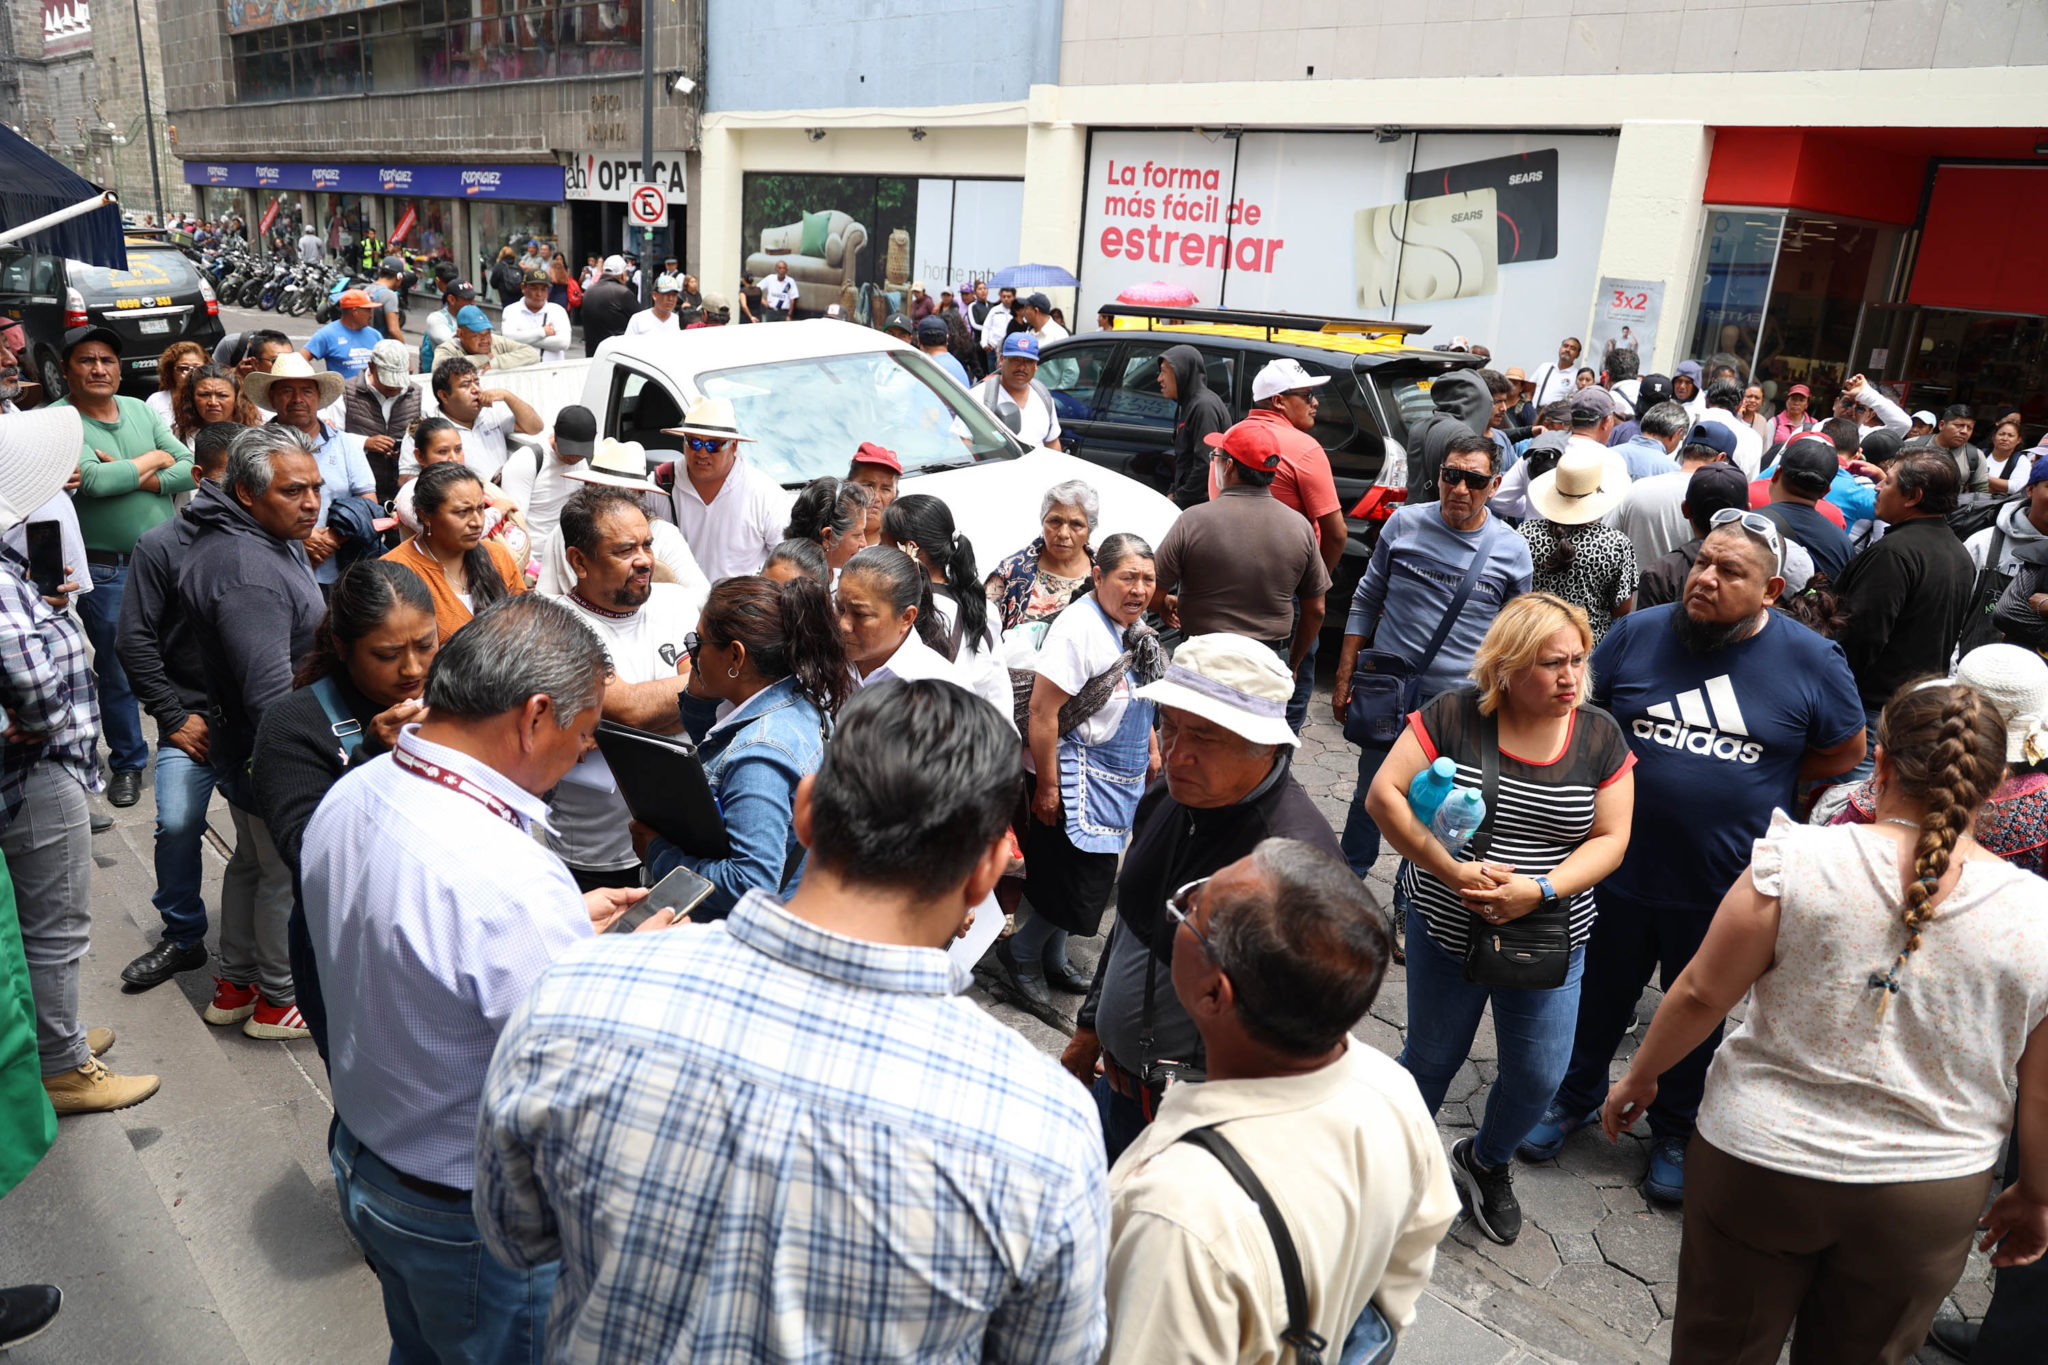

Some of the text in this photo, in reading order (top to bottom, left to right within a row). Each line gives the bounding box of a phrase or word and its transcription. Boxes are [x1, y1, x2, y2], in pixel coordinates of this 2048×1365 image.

[598, 160, 685, 193] OPTCA
[1107, 160, 1220, 191] La forma
[1508, 170, 1543, 186] SEARS
[642, 193, 655, 216] E
[1104, 190, 1262, 226] más fácil de
[1450, 209, 1484, 224] SEARS
[1100, 223, 1285, 274] estrenar
[923, 258, 965, 283] home
[1611, 289, 1649, 311] 3x2
[1631, 718, 1764, 764] adidas
